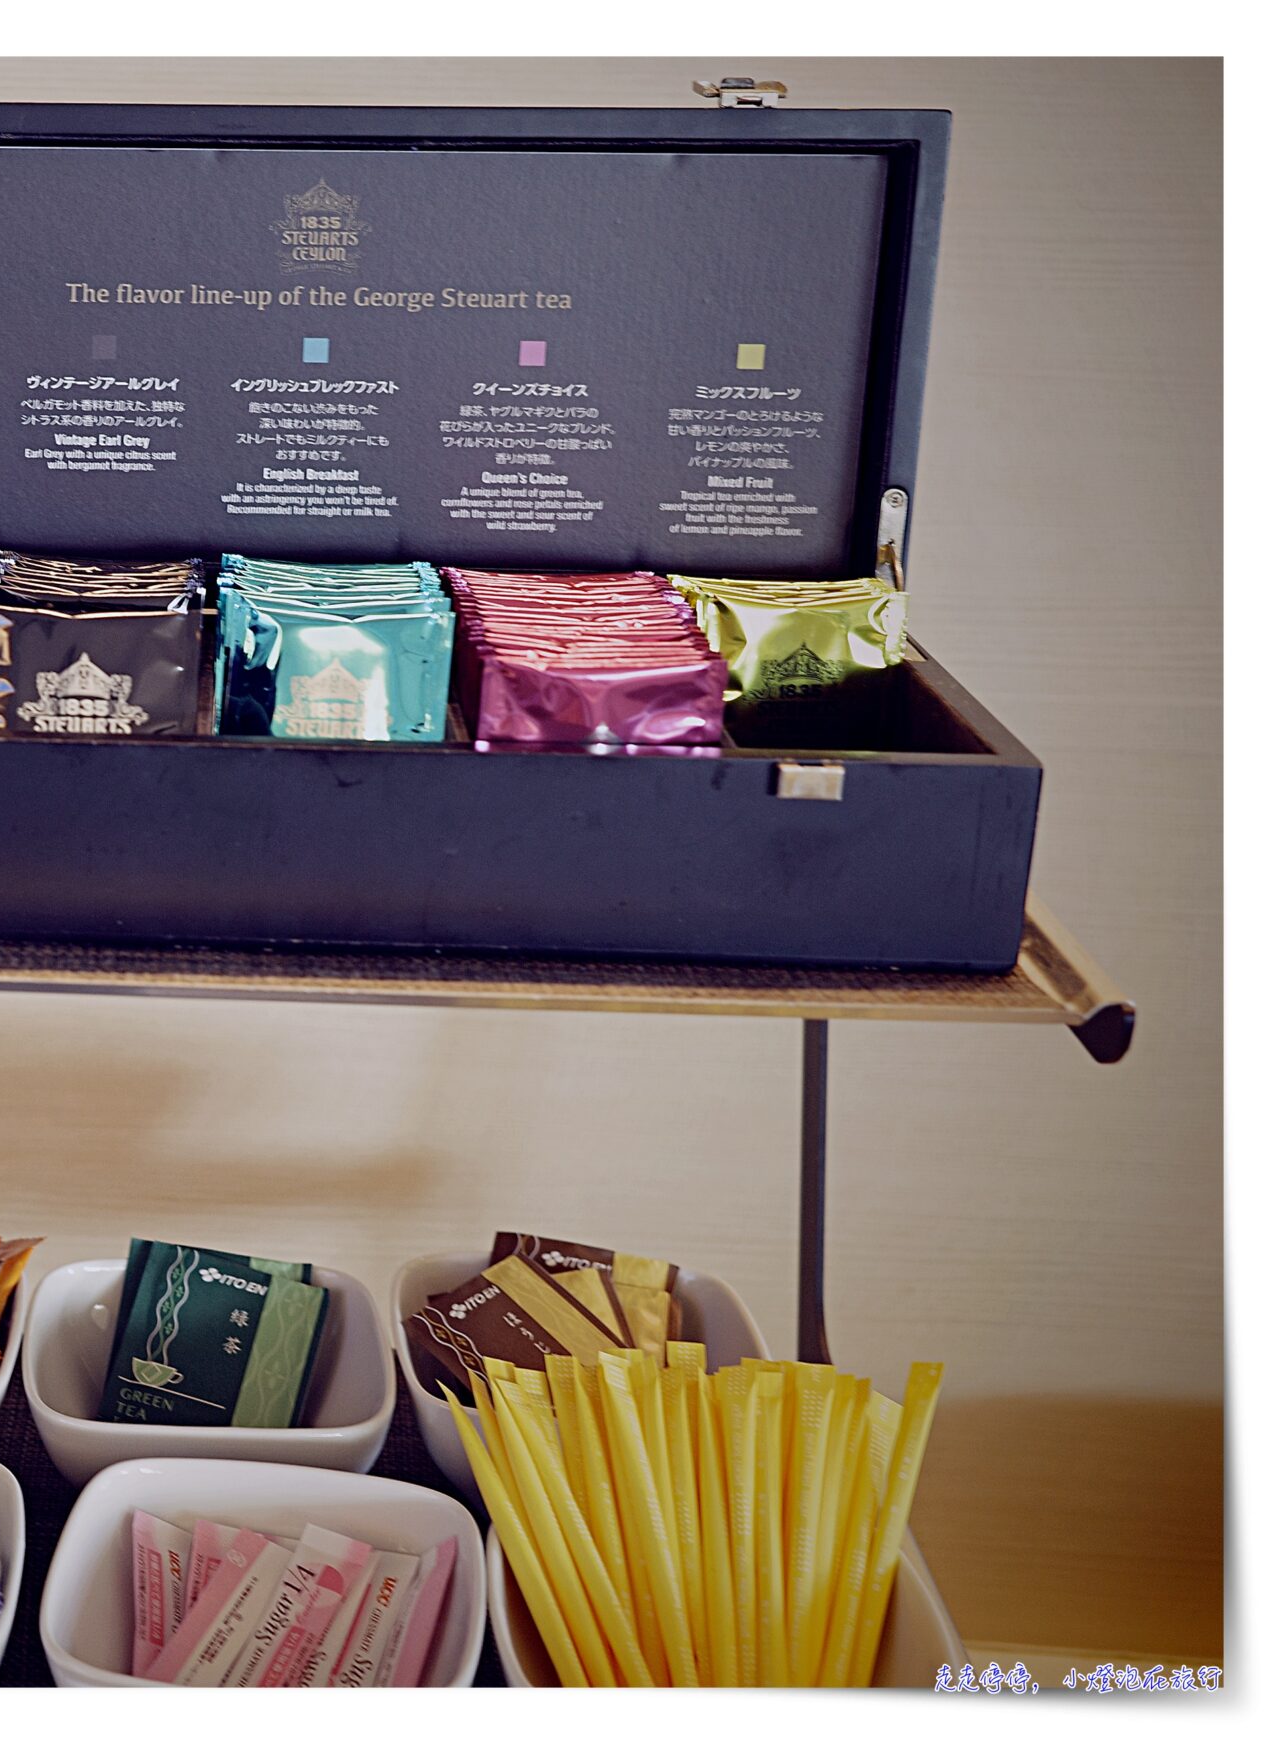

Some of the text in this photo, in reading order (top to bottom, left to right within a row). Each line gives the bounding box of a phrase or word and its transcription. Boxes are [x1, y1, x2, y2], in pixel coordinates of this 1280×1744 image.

[300, 216, 341, 229] 1835
[281, 230, 358, 246] STEUARTS
[292, 246, 346, 262] CEYLON
[66, 283, 572, 312] The flavor line-up of the George Steuart tea
[27, 376, 179, 390] ヴィンテージアールグレイ
[231, 378, 400, 394] イングリッシュブレックファスト
[473, 383, 588, 397] クイーンズチョイス
[696, 386, 801, 400] ミックスフルーツ
[54, 434, 150, 449] Vintage Earl Grey
[25, 449, 42, 458] Earl
[44, 449, 64, 460] Grey
[66, 450, 85, 459] with
[94, 450, 124, 461] unique
[125, 451, 150, 460] citrus
[152, 452, 176, 460] scent
[48, 461, 67, 470] with
[68, 461, 110, 471] bergamot
[263, 467, 359, 481] English Breakfast
[482, 472, 568, 485] Queen's Choice
[237, 483, 243, 491] It
[245, 483, 253, 492] is
[315, 484, 325, 495] by
[359, 485, 382, 494] taste
[708, 475, 774, 489] Mixed Fruit
[460, 487, 468, 496] A
[221, 494, 241, 503] with
[307, 497, 323, 506] you
[352, 496, 363, 505] be
[293, 505, 306, 515] for
[354, 506, 373, 516] milk
[59, 698, 109, 716] 1835
[33, 715, 133, 735] STEUARTS
[223, 1308, 250, 1354] 緑茶
[120, 1387, 174, 1411] GREEN
[116, 1402, 147, 1420] TEA
[256, 1593, 294, 1646] Sugar
